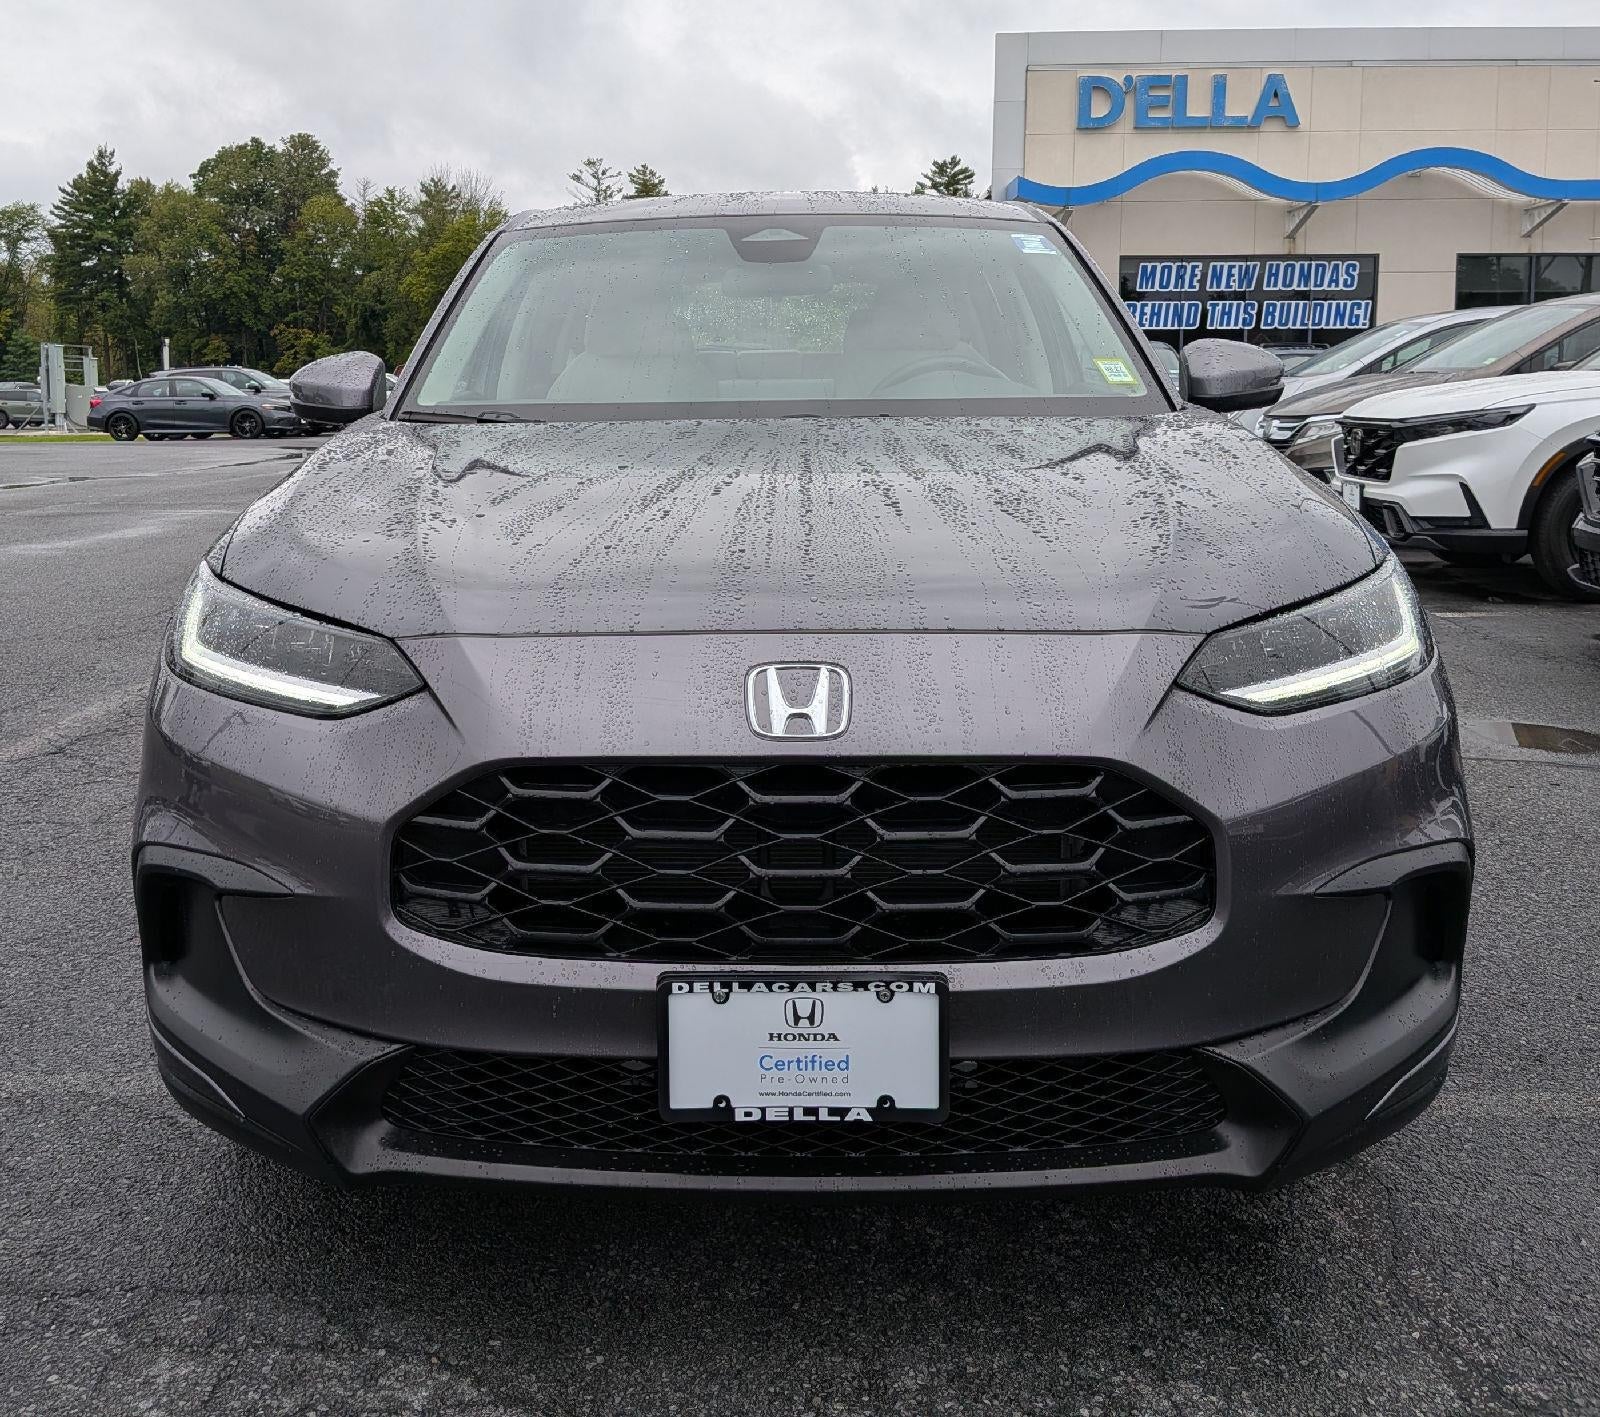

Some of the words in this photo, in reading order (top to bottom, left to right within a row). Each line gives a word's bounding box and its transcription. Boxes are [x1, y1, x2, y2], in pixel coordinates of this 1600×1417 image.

[1076, 73, 1301, 130] D'ELLA
[1137, 262, 1202, 291] MORE
[1206, 261, 1260, 291] NEW
[1263, 261, 1360, 291] HONDAS
[1206, 301, 1258, 330] THIS
[1261, 300, 1372, 330] BUILDING!
[671, 981, 936, 994] DELLACARS.COM
[767, 1032, 841, 1042] HONDA
[758, 1054, 851, 1072] Certified
[759, 1073, 850, 1084] Pre-Owned
[758, 1090, 852, 1098] www.HondaCertified.com
[734, 1107, 874, 1122] DELLA
